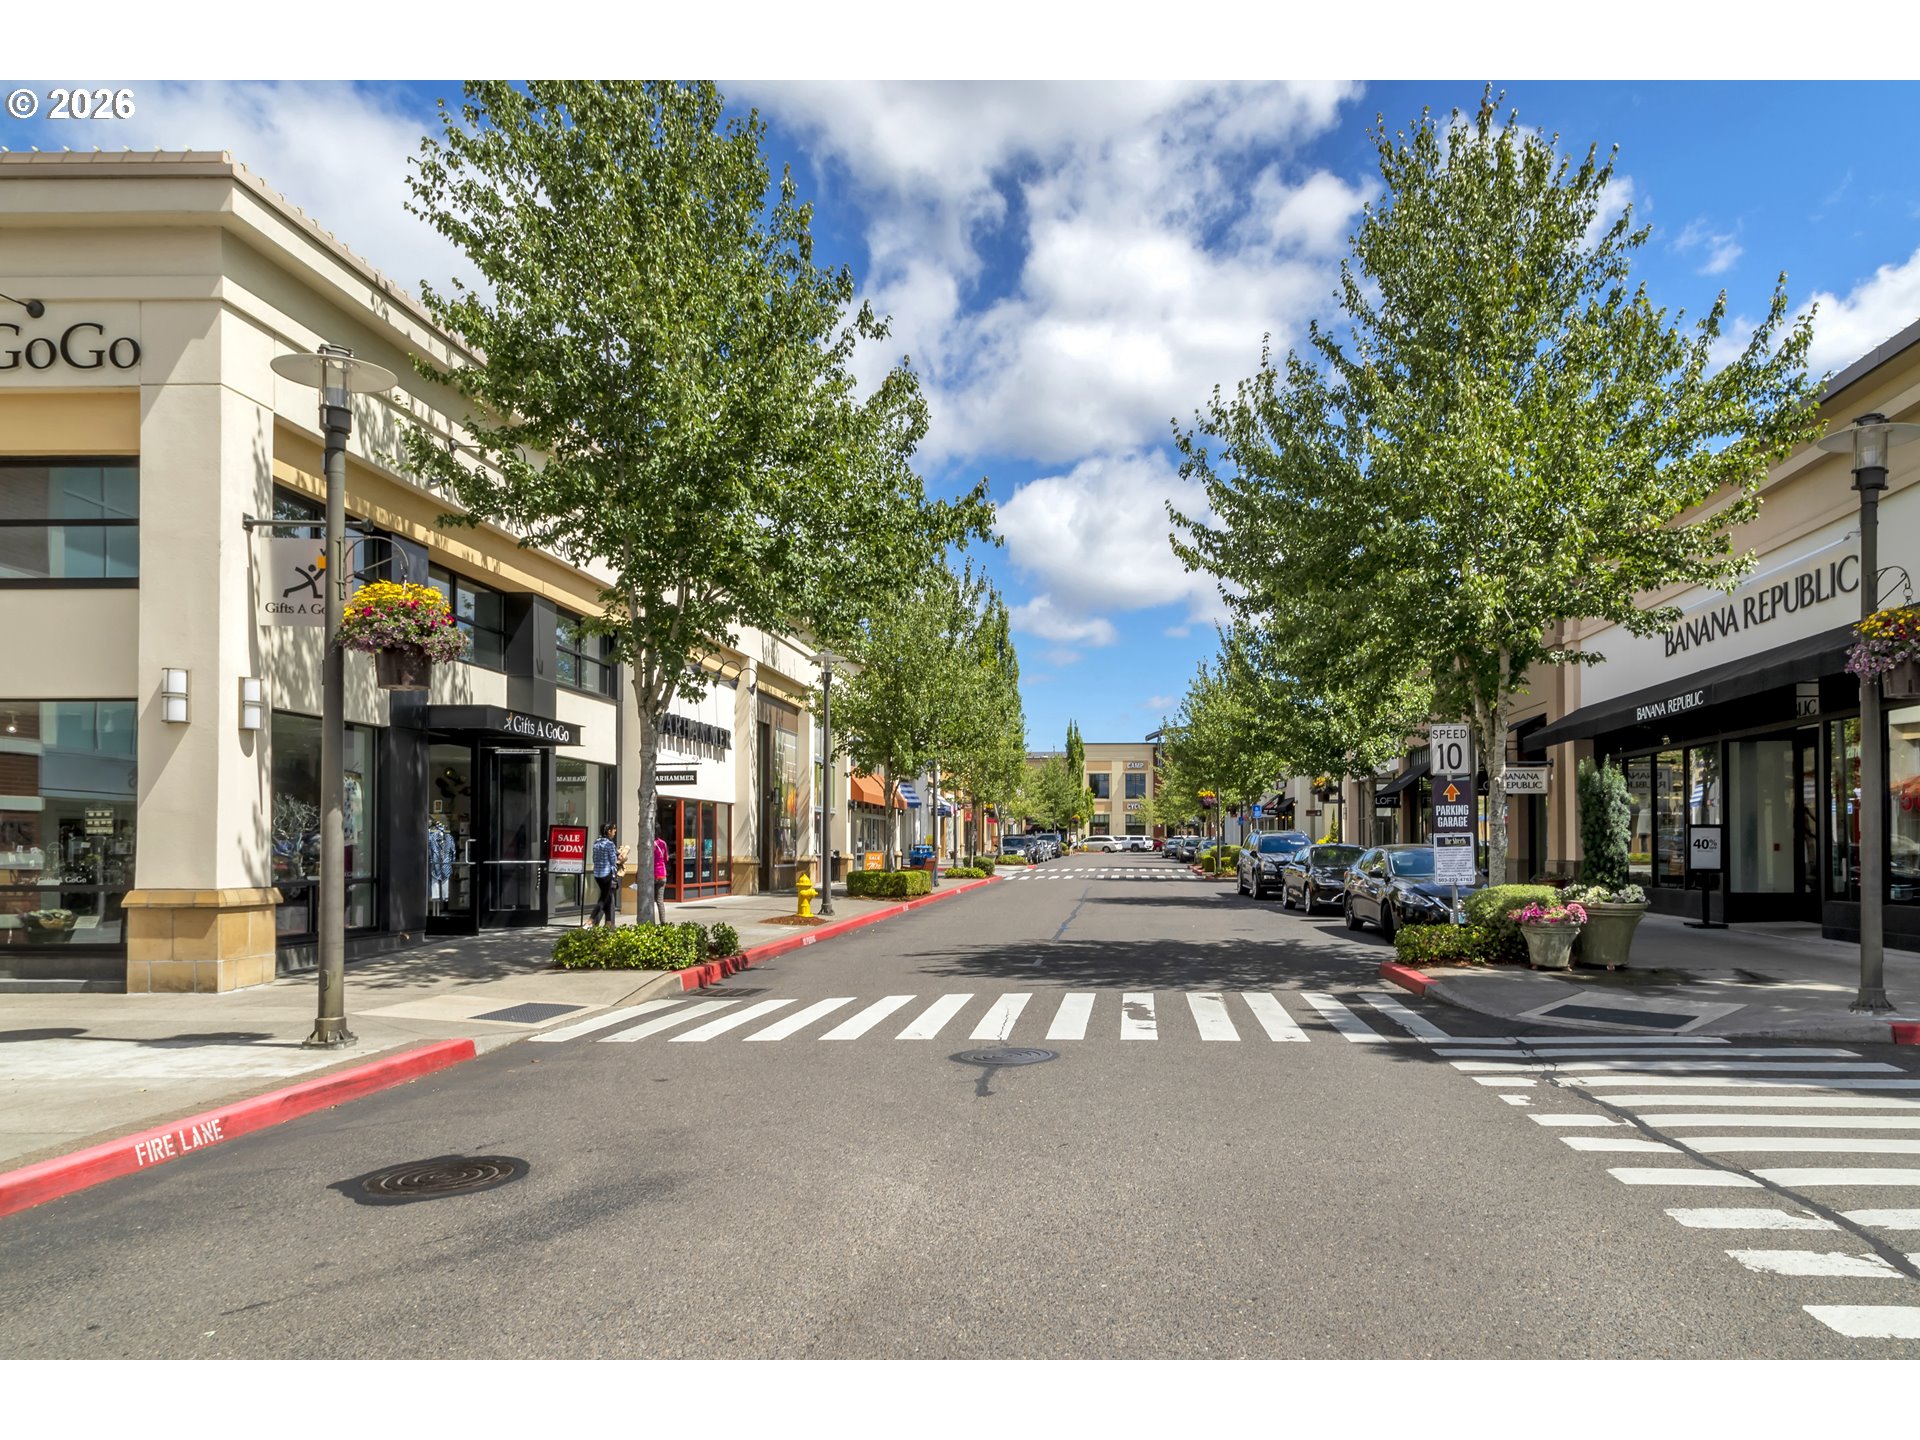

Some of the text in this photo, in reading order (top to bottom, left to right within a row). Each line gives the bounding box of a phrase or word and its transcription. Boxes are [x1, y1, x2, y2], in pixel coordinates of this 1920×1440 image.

[265, 602, 326, 615] Gifts A Go
[1665, 554, 1860, 658] BANANA REPUBLIC
[1636, 690, 1704, 721] BANANA REPUBLIC
[513, 715, 570, 742] Gifts A GoGo
[1432, 729, 1467, 739] SPEED
[1437, 742, 1463, 770] 10
[655, 774, 695, 782] ARHAMMER
[1375, 796, 1398, 805] LOFT
[1435, 804, 1469, 816] PARKING
[1437, 816, 1468, 828] GARAGE
[558, 835, 580, 843] SALE
[553, 844, 584, 853] TODAY
[65, 876, 87, 884] GoGo
[135, 1119, 224, 1166] FIRE LANE
